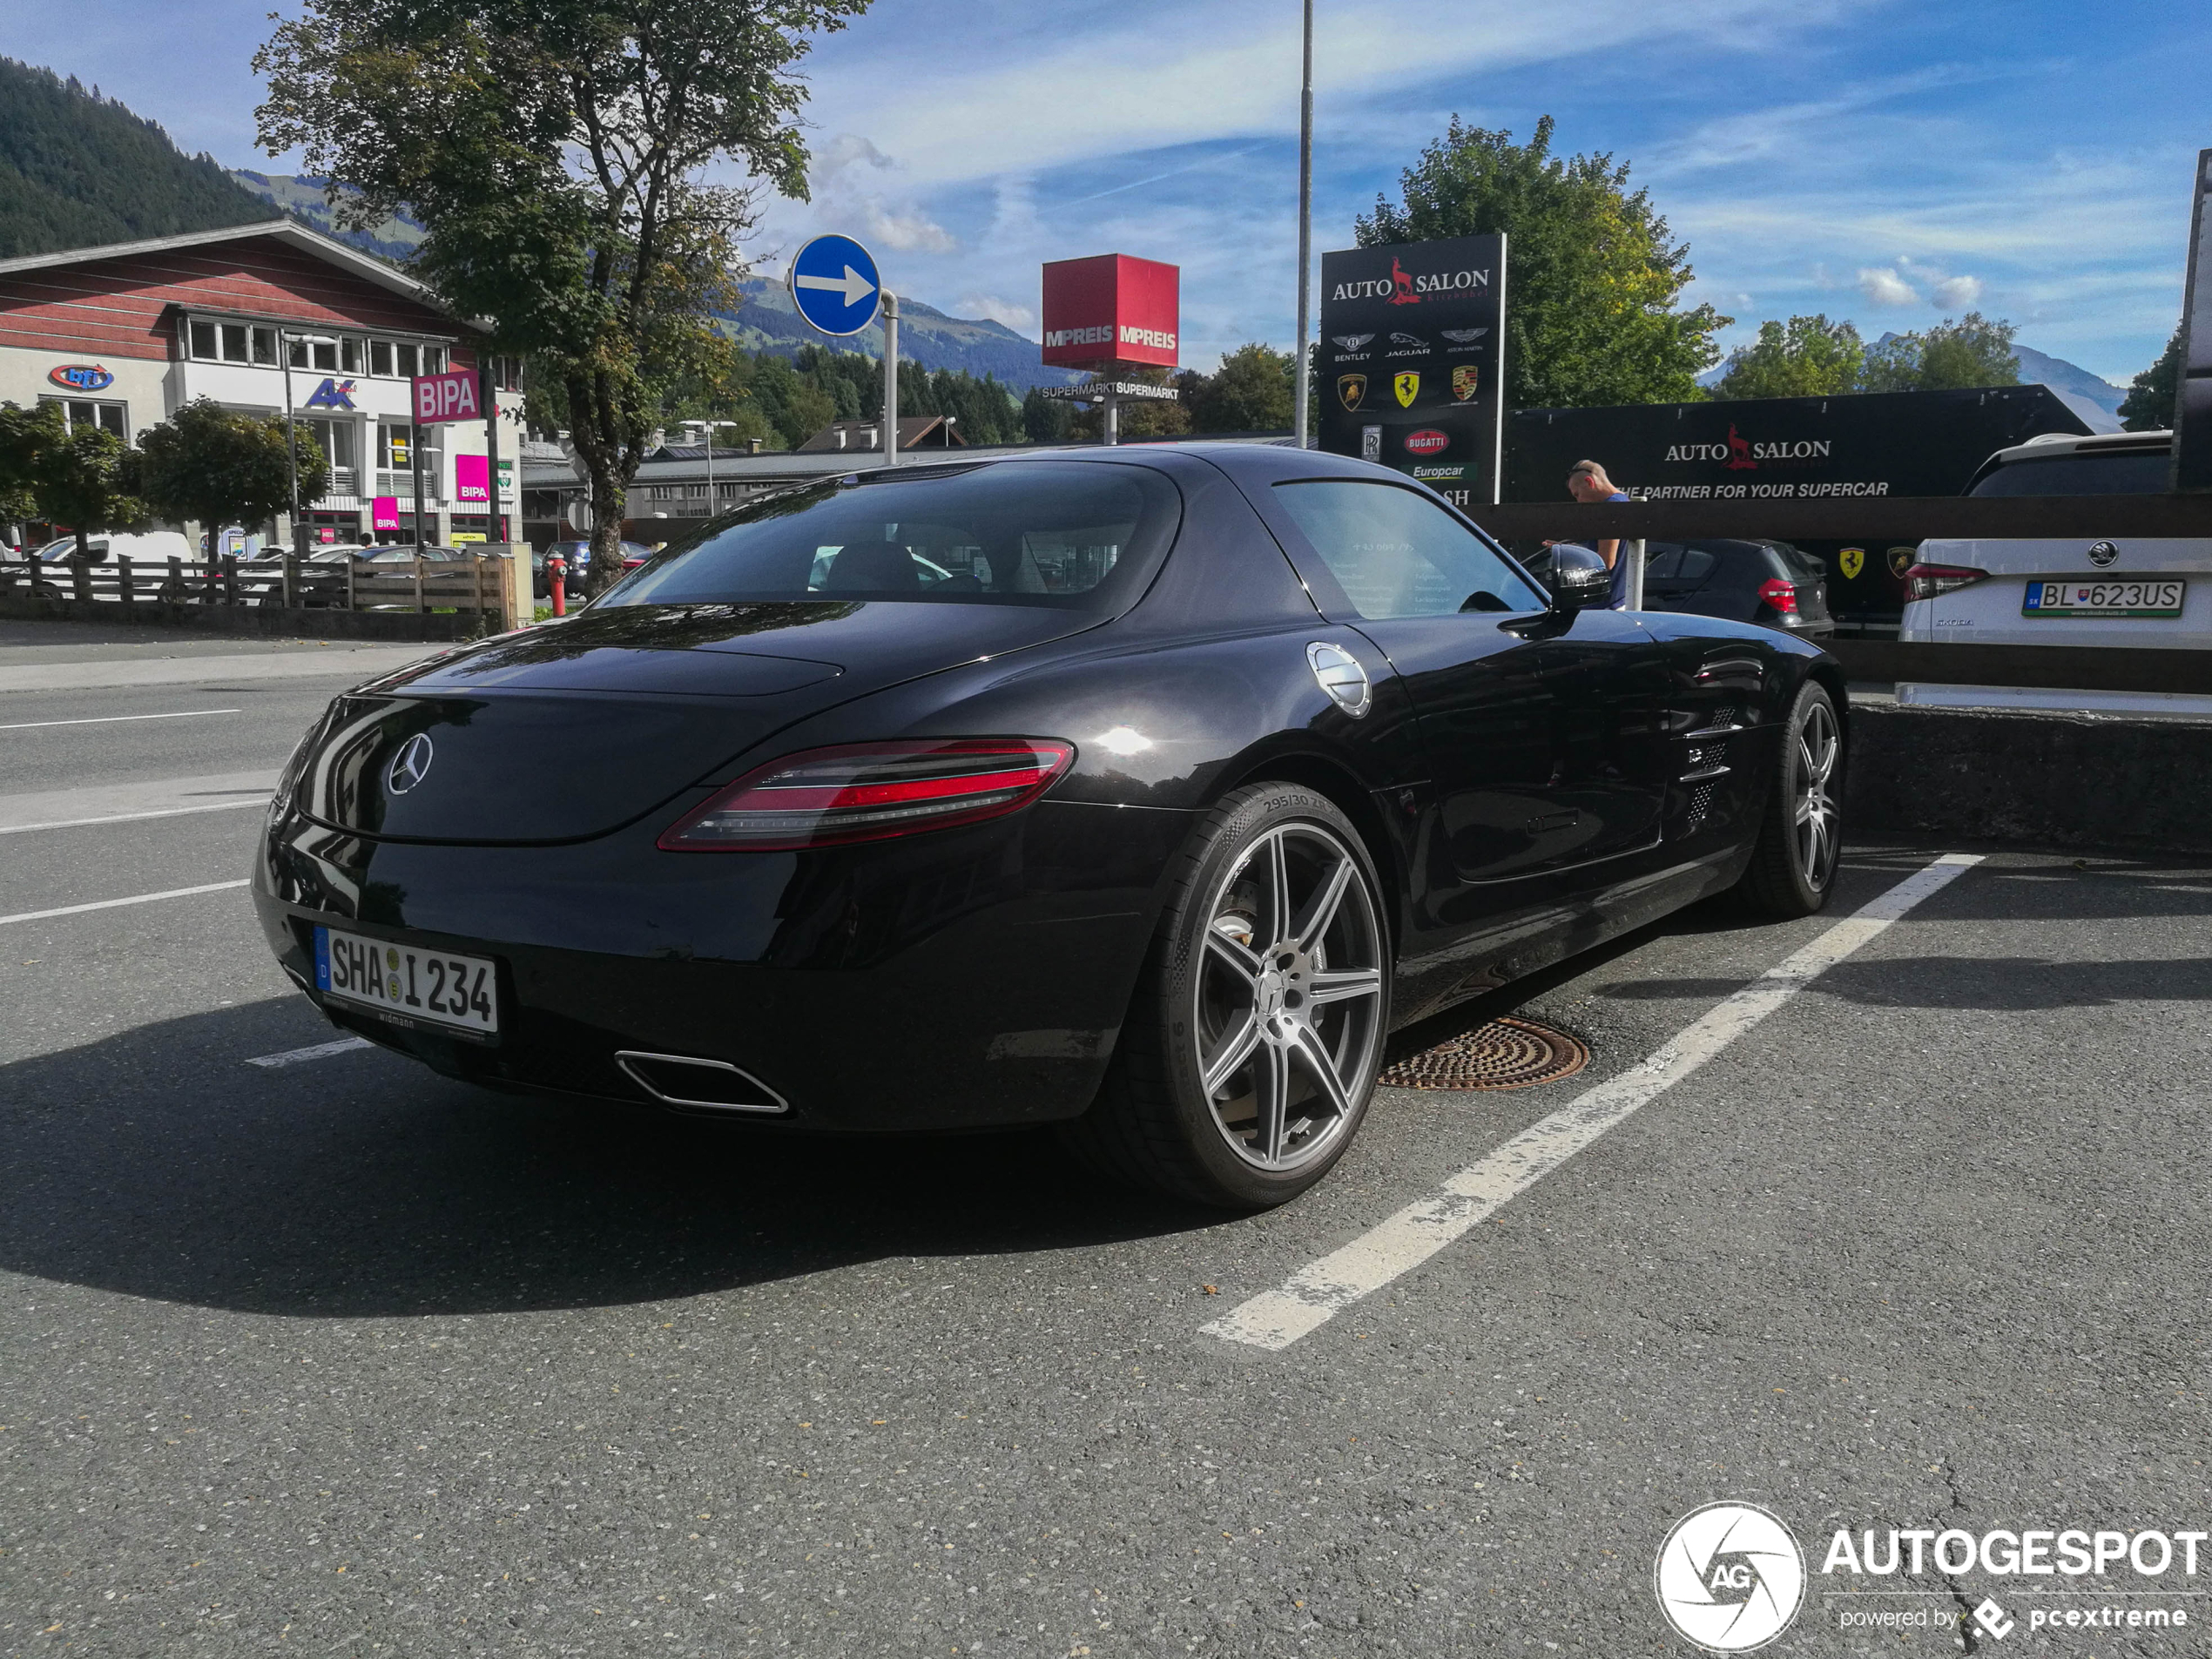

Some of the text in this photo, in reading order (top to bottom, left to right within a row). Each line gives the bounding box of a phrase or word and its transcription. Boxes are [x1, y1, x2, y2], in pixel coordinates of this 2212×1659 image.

[1332, 269, 1490, 301] AUTO SALON
[1046, 325, 1114, 347] MPREIS
[1120, 325, 1177, 350] MPREIS
[1334, 353, 1372, 361] BENTLEY
[1385, 348, 1431, 358] JAGUAR
[69, 368, 99, 389] bfi
[307, 378, 356, 408] AK
[419, 377, 476, 418] BIPA
[1042, 381, 1117, 398] SUPERMARKT
[1116, 381, 1179, 400] SUPERMARKT
[1409, 437, 1445, 448] BUGATTI
[1664, 441, 1831, 462] AUTO SALON
[1413, 466, 1465, 479] Europcar
[460, 486, 488, 498] BIPA
[1642, 485, 1710, 499] PARTNER
[1714, 484, 1746, 498] FOR
[1750, 483, 1795, 498] YOUR
[1797, 482, 1890, 497] SUPERCAR
[376, 518, 398, 528] BIPA
[2043, 584, 2179, 607] BL 623US
[1263, 793, 1309, 813] 295/30
[320, 964, 327, 979] D
[333, 937, 385, 999] SHA
[427, 959, 491, 1022] 234
[379, 1011, 415, 1029] widmann
